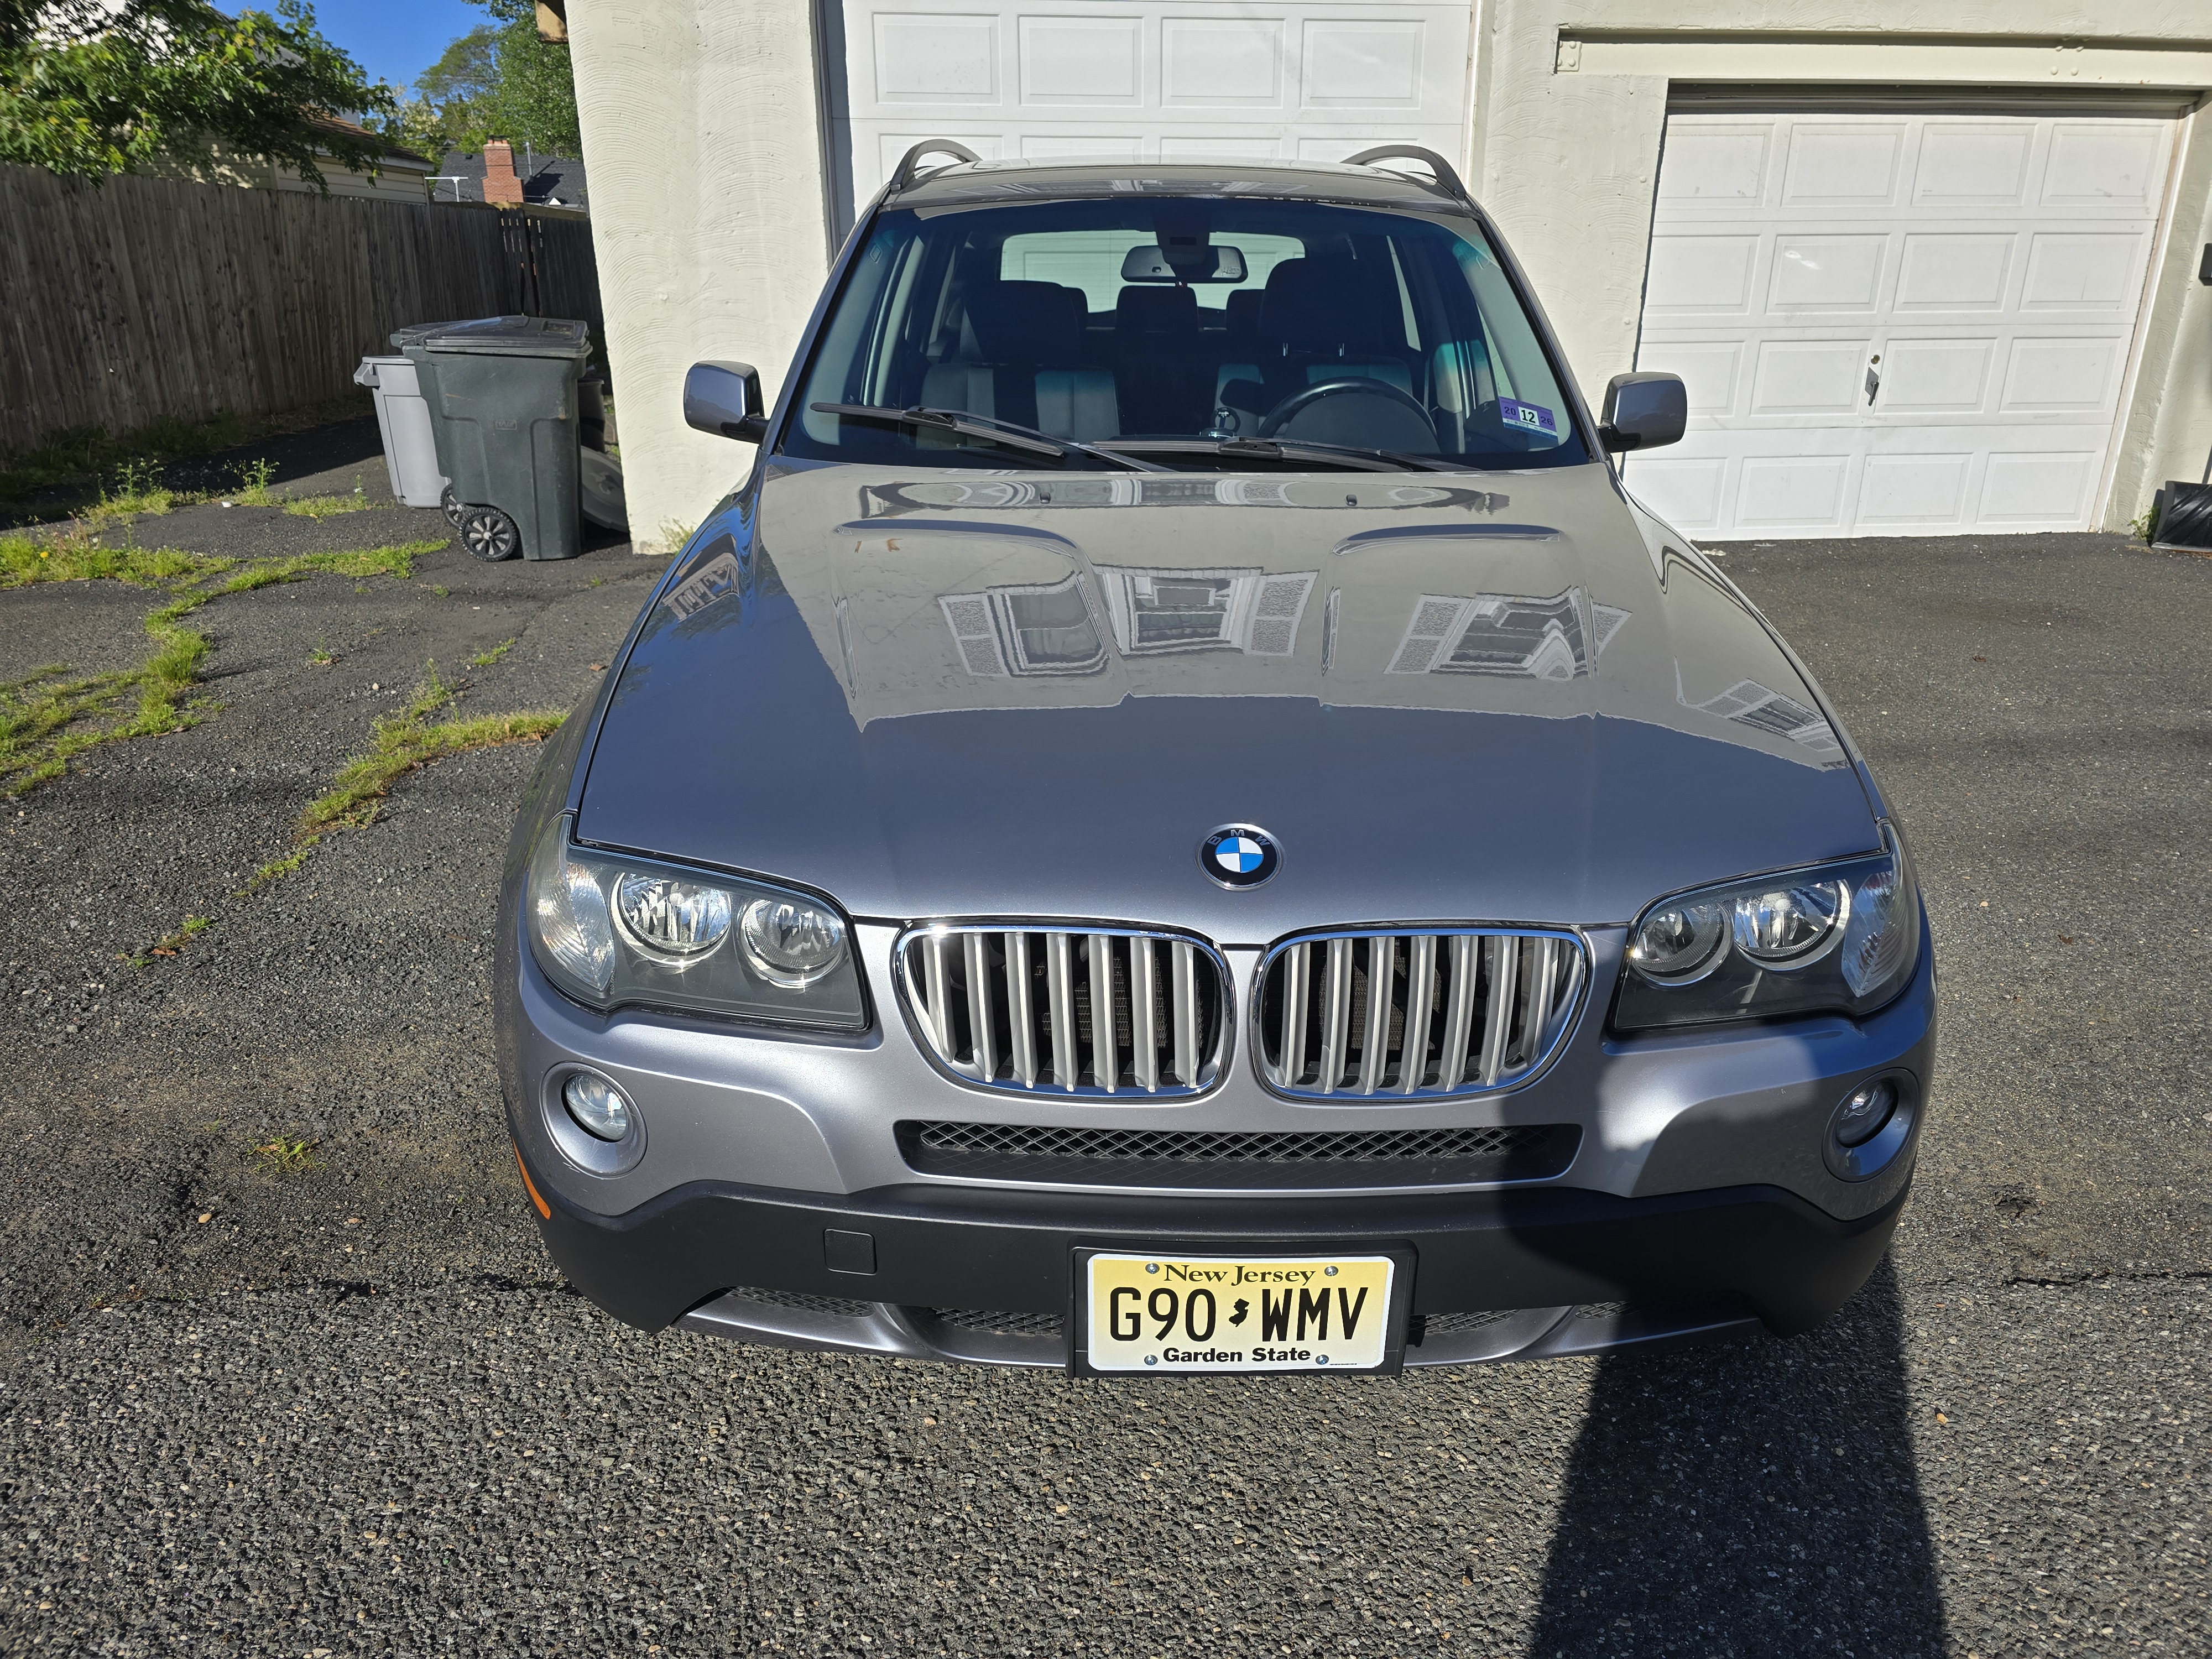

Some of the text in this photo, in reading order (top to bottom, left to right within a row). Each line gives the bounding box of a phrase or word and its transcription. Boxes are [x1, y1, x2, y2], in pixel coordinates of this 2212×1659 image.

[1504, 406, 1516, 415] 20
[1521, 410, 1536, 424] 12
[1540, 416, 1553, 426] 26
[1207, 830, 1270, 846] BMW
[1164, 1265, 1316, 1286] New Jersey
[1110, 1287, 1368, 1342] G90 WMV
[1163, 1347, 1311, 1363] Garden State
